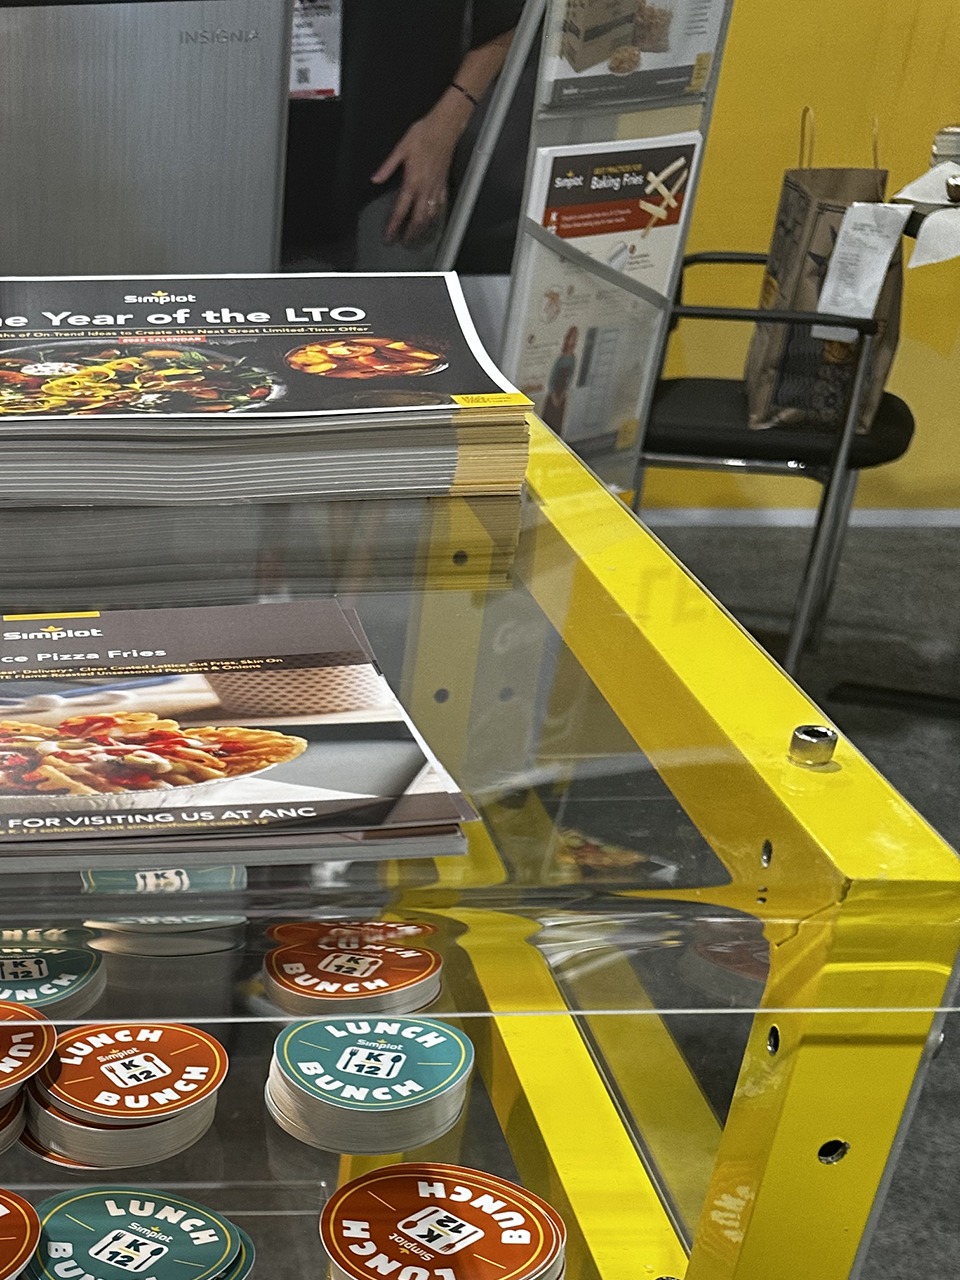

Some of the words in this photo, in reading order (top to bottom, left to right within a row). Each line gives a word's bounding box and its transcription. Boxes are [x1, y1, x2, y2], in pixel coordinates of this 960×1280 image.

[180, 29, 258, 45] INSIGNIA
[591, 176, 620, 190] Baking
[623, 173, 644, 185] Fries
[124, 294, 196, 304] Simplot
[42, 311, 134, 326] Year
[146, 309, 190, 324] of
[202, 308, 270, 323] the
[286, 306, 366, 322] LTO
[3, 628, 103, 641] Simplot
[37, 652, 99, 662] Pizza
[108, 649, 167, 659] Fries
[8, 817, 61, 829] FOR
[64, 812, 174, 826] VISITING
[181, 810, 215, 822] US
[221, 809, 252, 820] AT
[253, 806, 317, 818] ANC
[346, 956, 364, 964] K
[282, 962, 390, 993] BUNCH
[333, 965, 357, 974] 12
[324, 1022, 447, 1048] LUNCH
[58, 1029, 163, 1066] LUNCH
[356, 1038, 404, 1051] Simplot
[96, 1047, 140, 1063] Simplot
[365, 1052, 383, 1063] K
[124, 1060, 142, 1070] K
[354, 1064, 381, 1076] 12
[126, 1069, 157, 1085] 12
[297, 1061, 425, 1101] BUNCH
[93, 1066, 210, 1109] BUNCH
[417, 1181, 532, 1244] BUNCH
[104, 1199, 220, 1246] LUNCH
[436, 1215, 466, 1233] 12
[127, 1221, 173, 1244] Simplot
[416, 1228, 444, 1243] K
[124, 1239, 148, 1251] K
[388, 1232, 434, 1262] Simplot
[105, 1251, 134, 1264] 12
